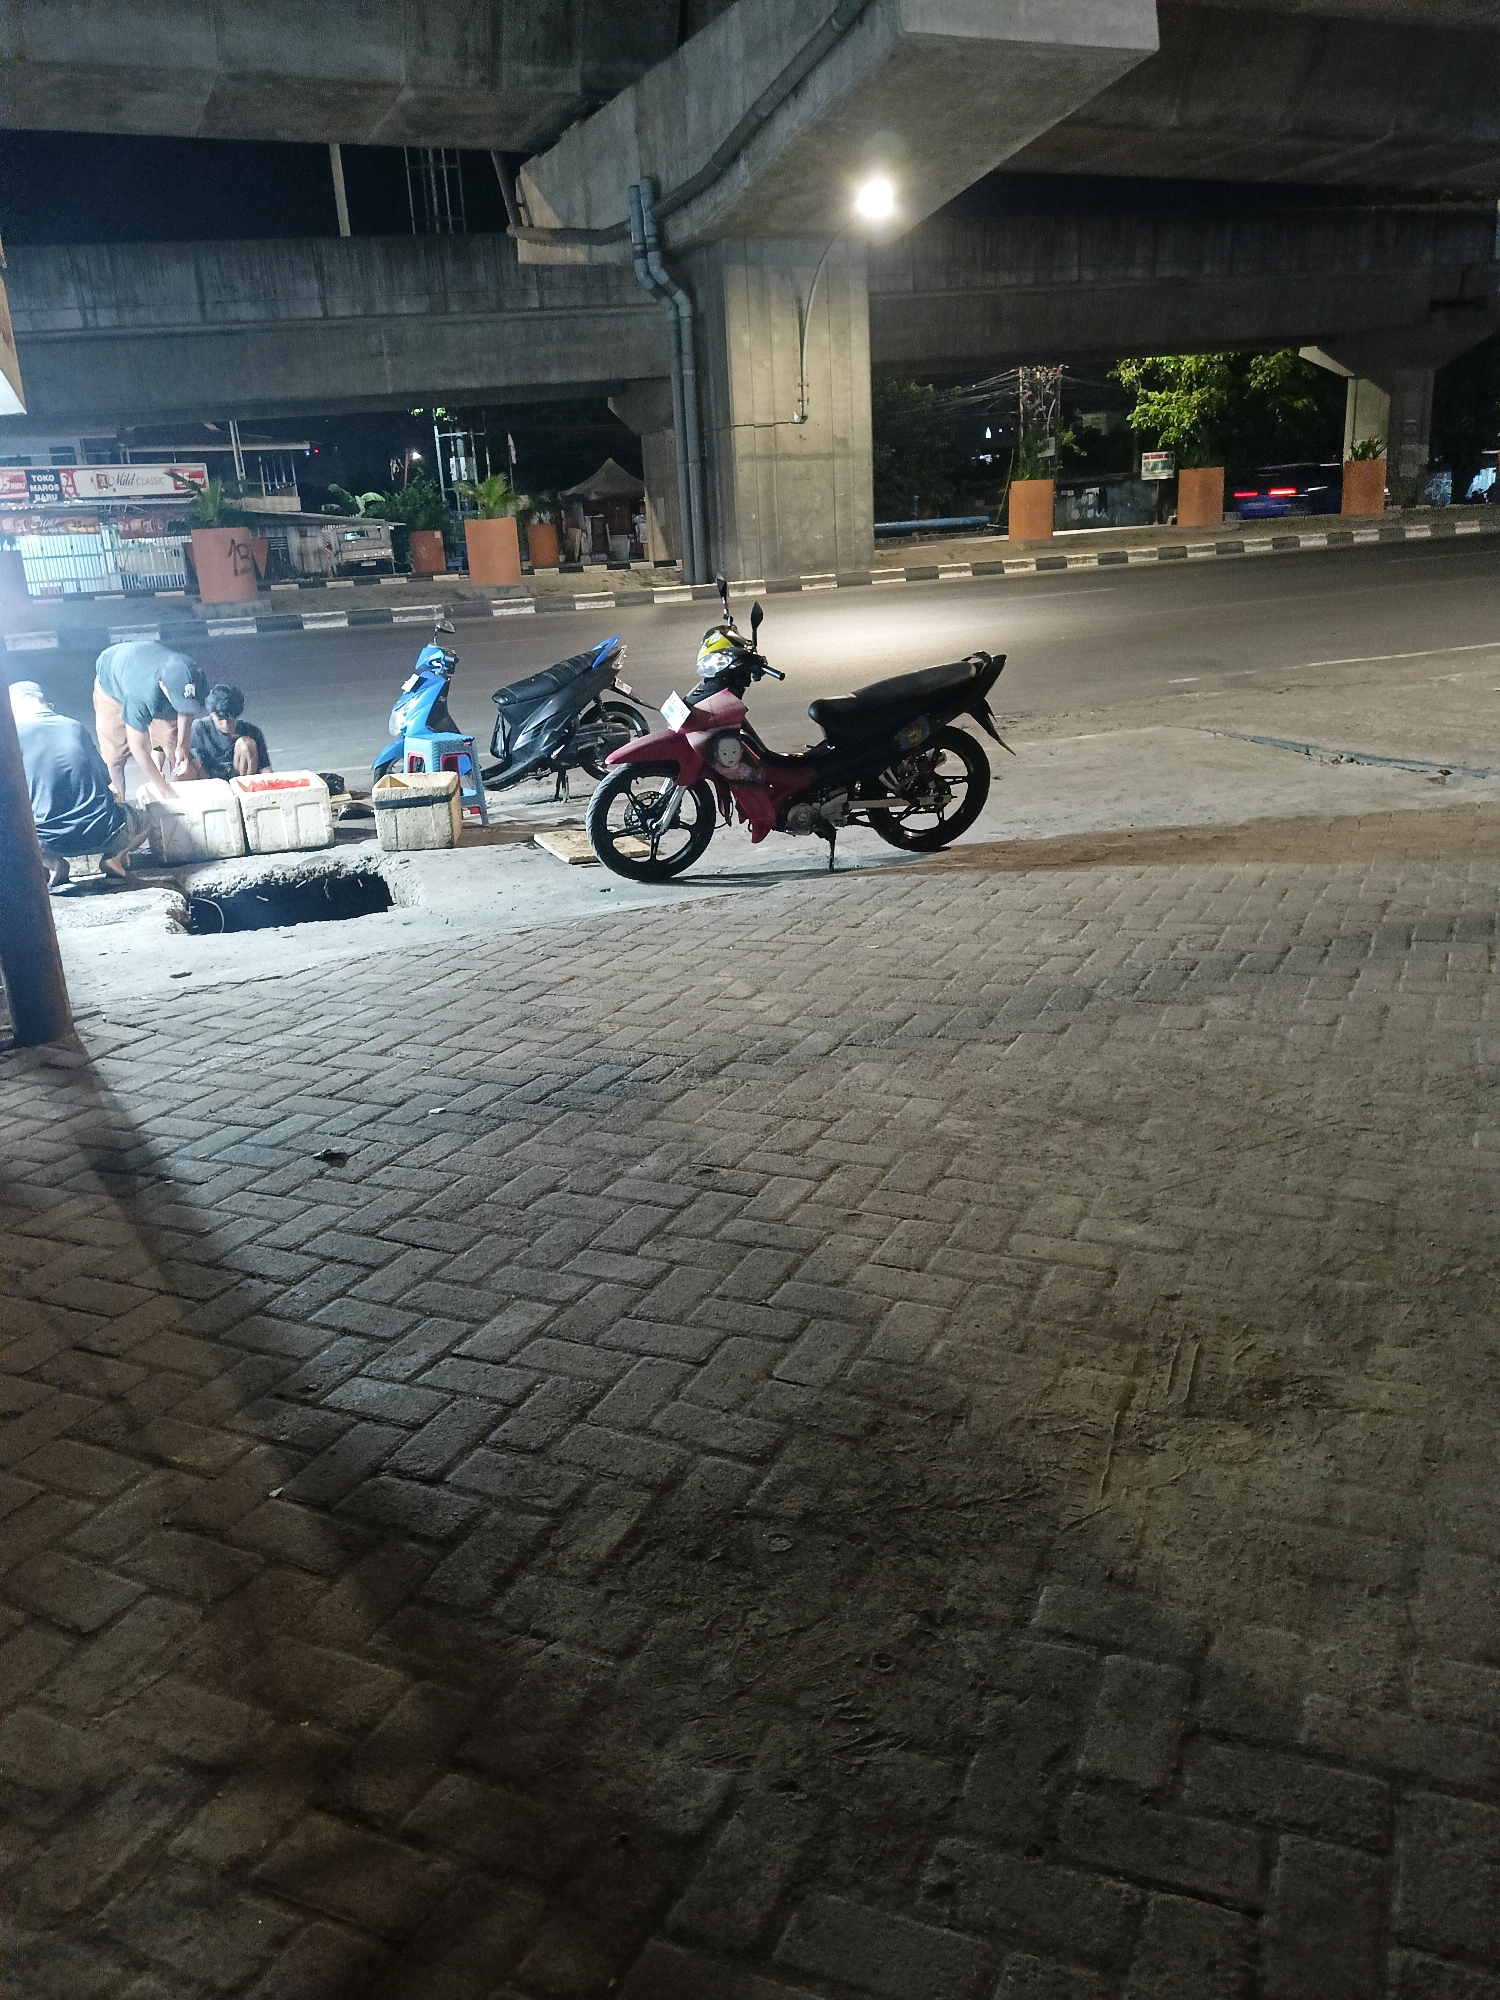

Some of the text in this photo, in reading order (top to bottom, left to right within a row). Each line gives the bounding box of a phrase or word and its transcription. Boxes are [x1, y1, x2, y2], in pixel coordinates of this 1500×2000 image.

[31, 474, 55, 482] TOKO
[136, 476, 165, 486] CLASSIC
[29, 484, 60, 492] MAROS
